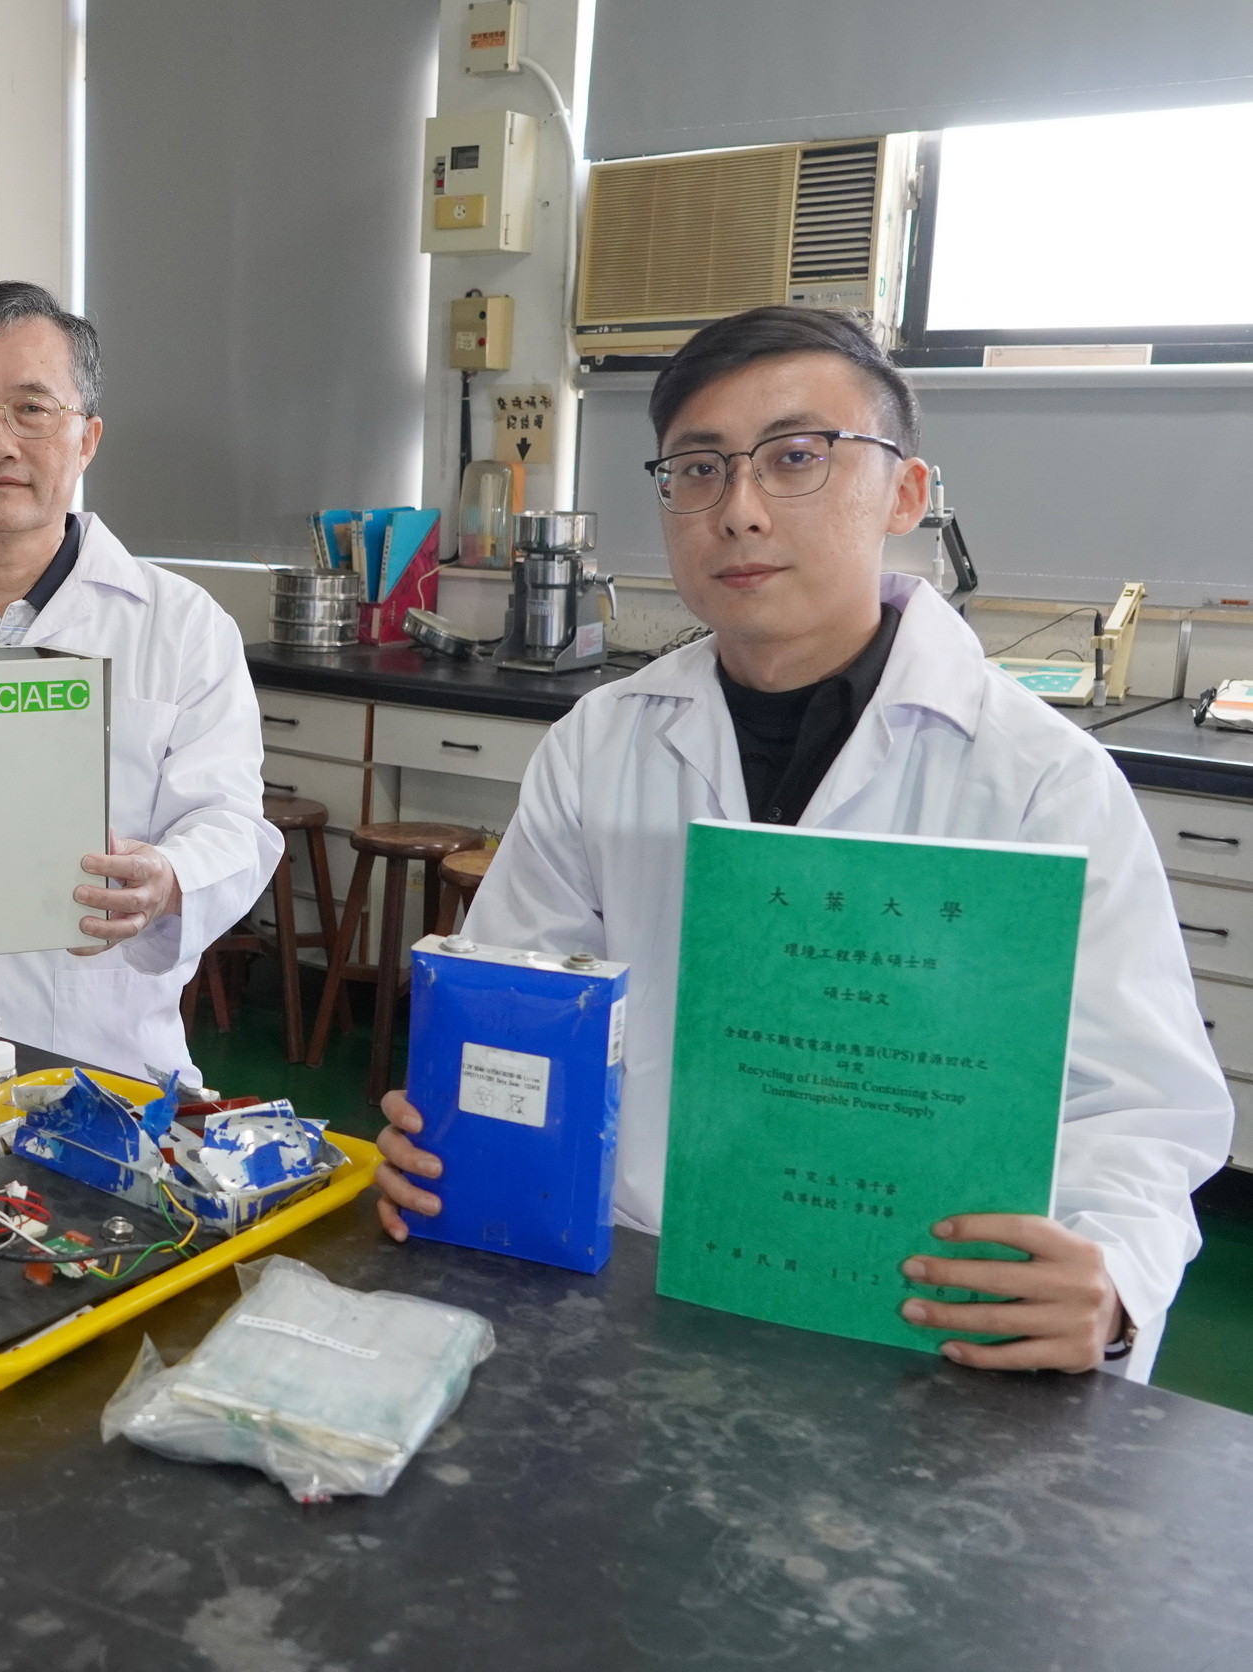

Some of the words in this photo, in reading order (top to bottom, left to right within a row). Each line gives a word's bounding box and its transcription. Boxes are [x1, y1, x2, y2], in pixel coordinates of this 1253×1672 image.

[768, 886, 964, 923] 大葉大學
[823, 986, 890, 1006] 碩士論文
[738, 1061, 794, 1084] Recycling
[796, 1073, 811, 1083] of
[812, 1074, 859, 1091] Lithium
[861, 1080, 928, 1101] Containing
[931, 1089, 966, 1106] Scrap
[762, 1082, 849, 1106] Uninterruptible
[852, 1096, 890, 1112] Power
[893, 1101, 935, 1120] Supply
